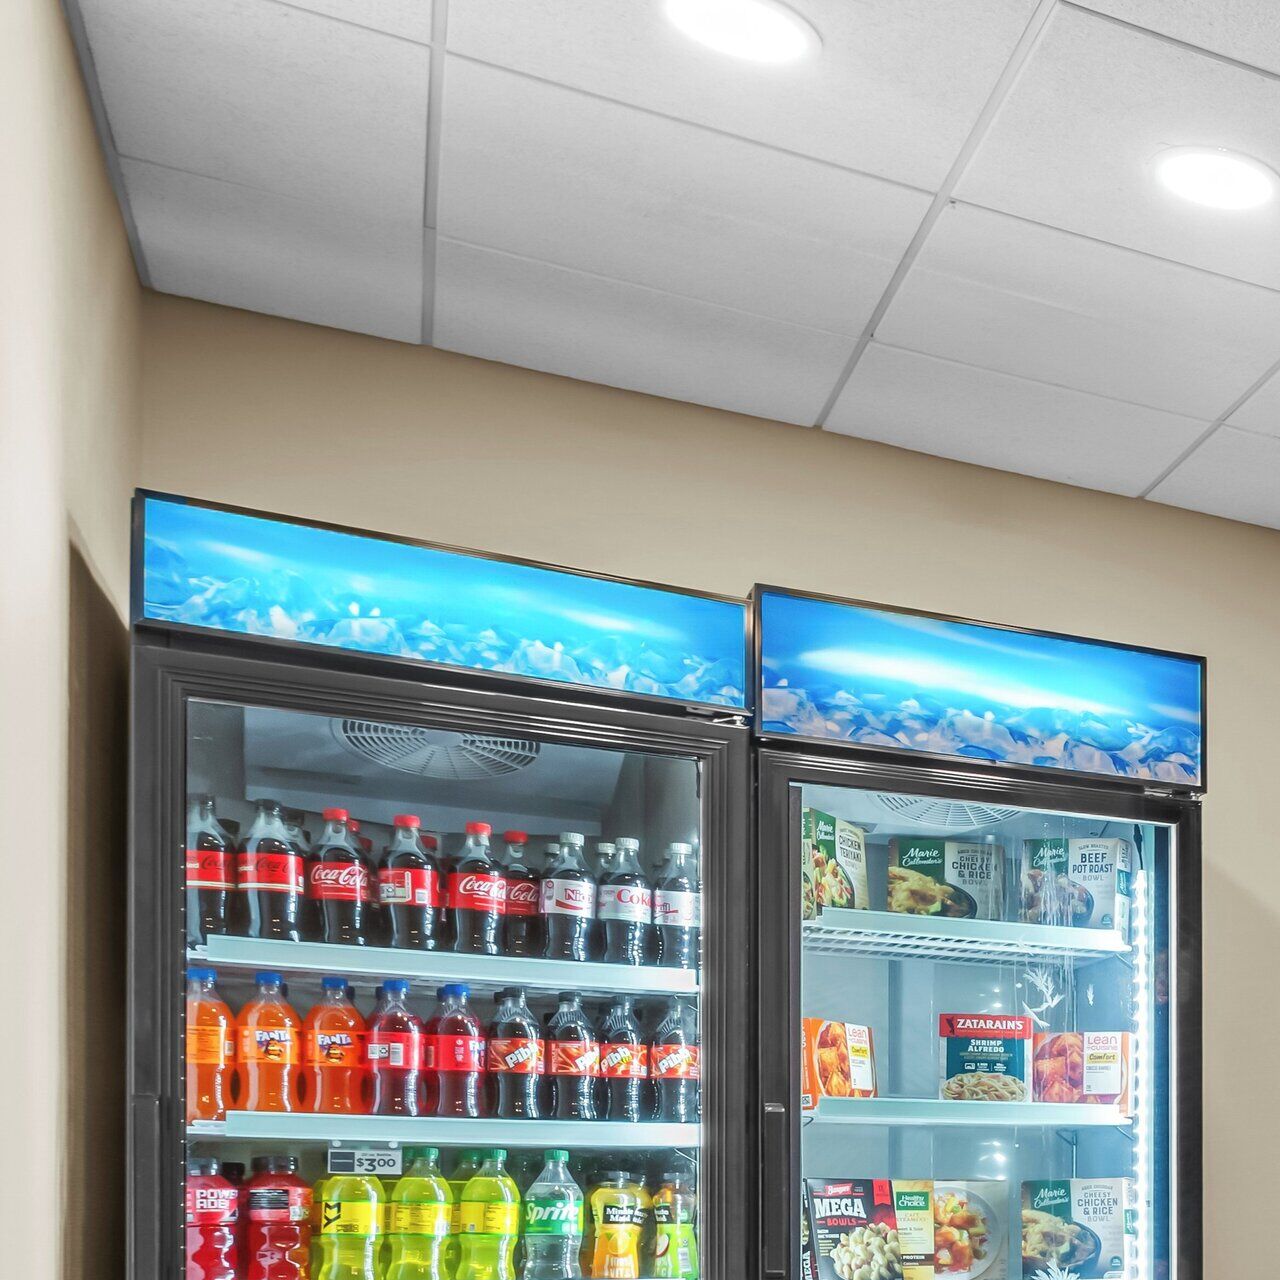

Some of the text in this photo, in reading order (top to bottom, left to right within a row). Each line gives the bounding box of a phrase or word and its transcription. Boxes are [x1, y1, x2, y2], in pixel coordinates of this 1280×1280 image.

[838, 834, 862, 851] CHICKEN
[902, 847, 940, 859] Marie
[1080, 852, 1108, 864] BEEF
[1072, 863, 1114, 874] POT ROAST
[310, 864, 368, 887] Coca-Cola
[968, 871, 992, 880] RICE
[956, 1018, 1025, 1030] ZATARAIN'S
[970, 1039, 1003, 1047] SHRIMP
[1087, 1035, 1118, 1045] Lean
[967, 1045, 1005, 1053] ALFREDO
[1089, 1053, 1116, 1061] Comfort
[901, 1194, 925, 1202] Healthy
[1034, 1187, 1068, 1200] Marie
[898, 1199, 927, 1207] Choice
[1077, 1197, 1119, 1207] CHICKEN
[525, 1201, 580, 1222] Sprite
[813, 1198, 867, 1219] MEGA
[1083, 1206, 1113, 1216] & RICE
[826, 1218, 858, 1227] BOWLS
